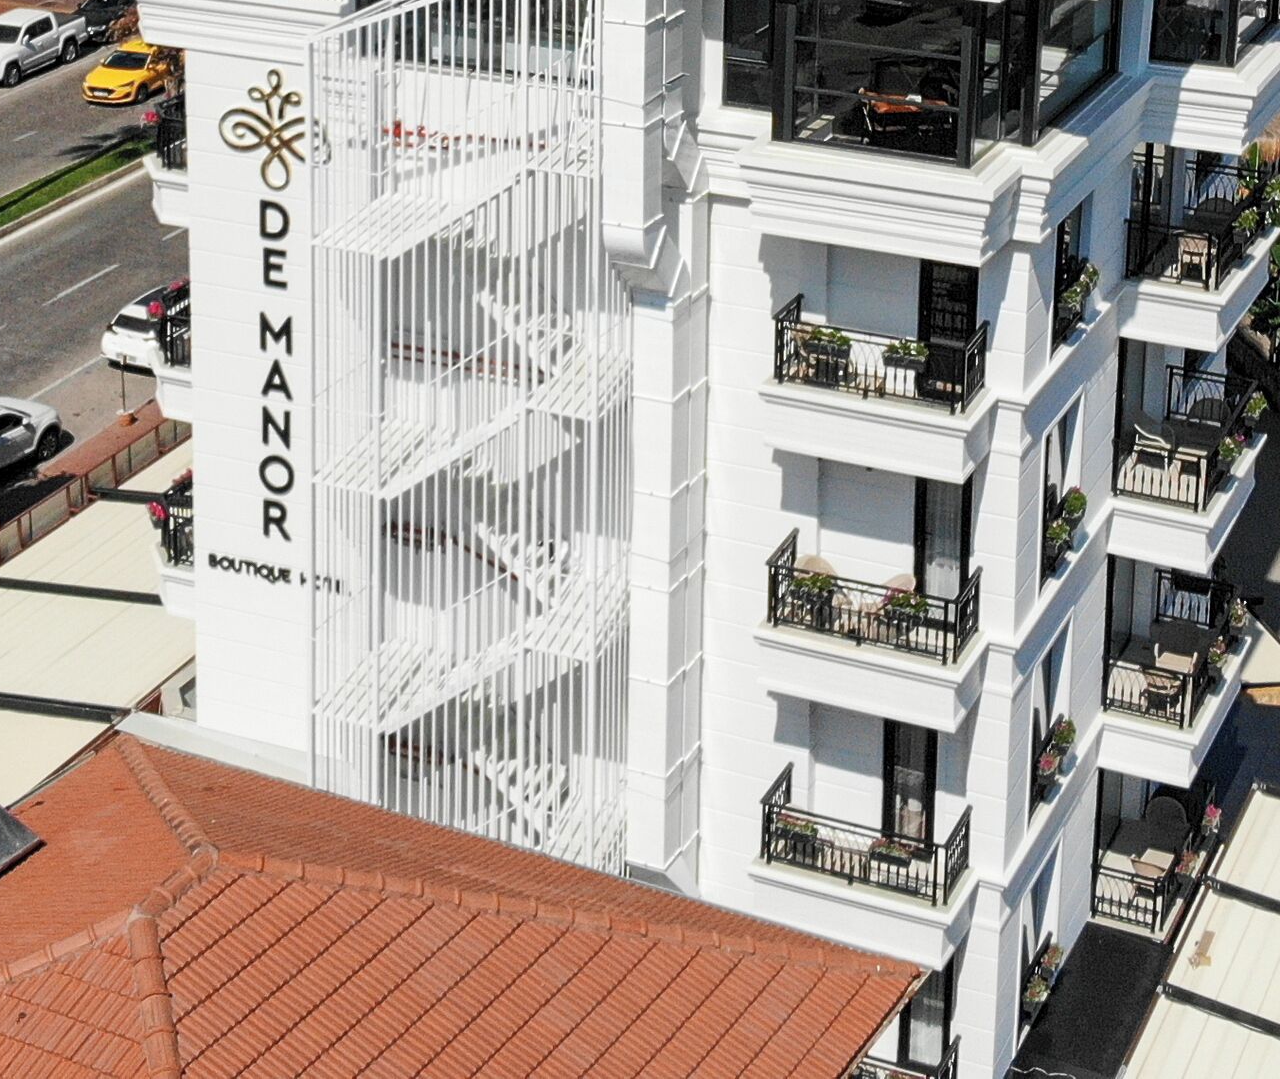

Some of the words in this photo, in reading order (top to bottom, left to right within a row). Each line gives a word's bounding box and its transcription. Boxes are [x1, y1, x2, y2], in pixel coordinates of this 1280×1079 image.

[259, 199, 291, 290] DE
[258, 310, 295, 542] MANOR
[208, 552, 292, 585] BOUTIQUE
